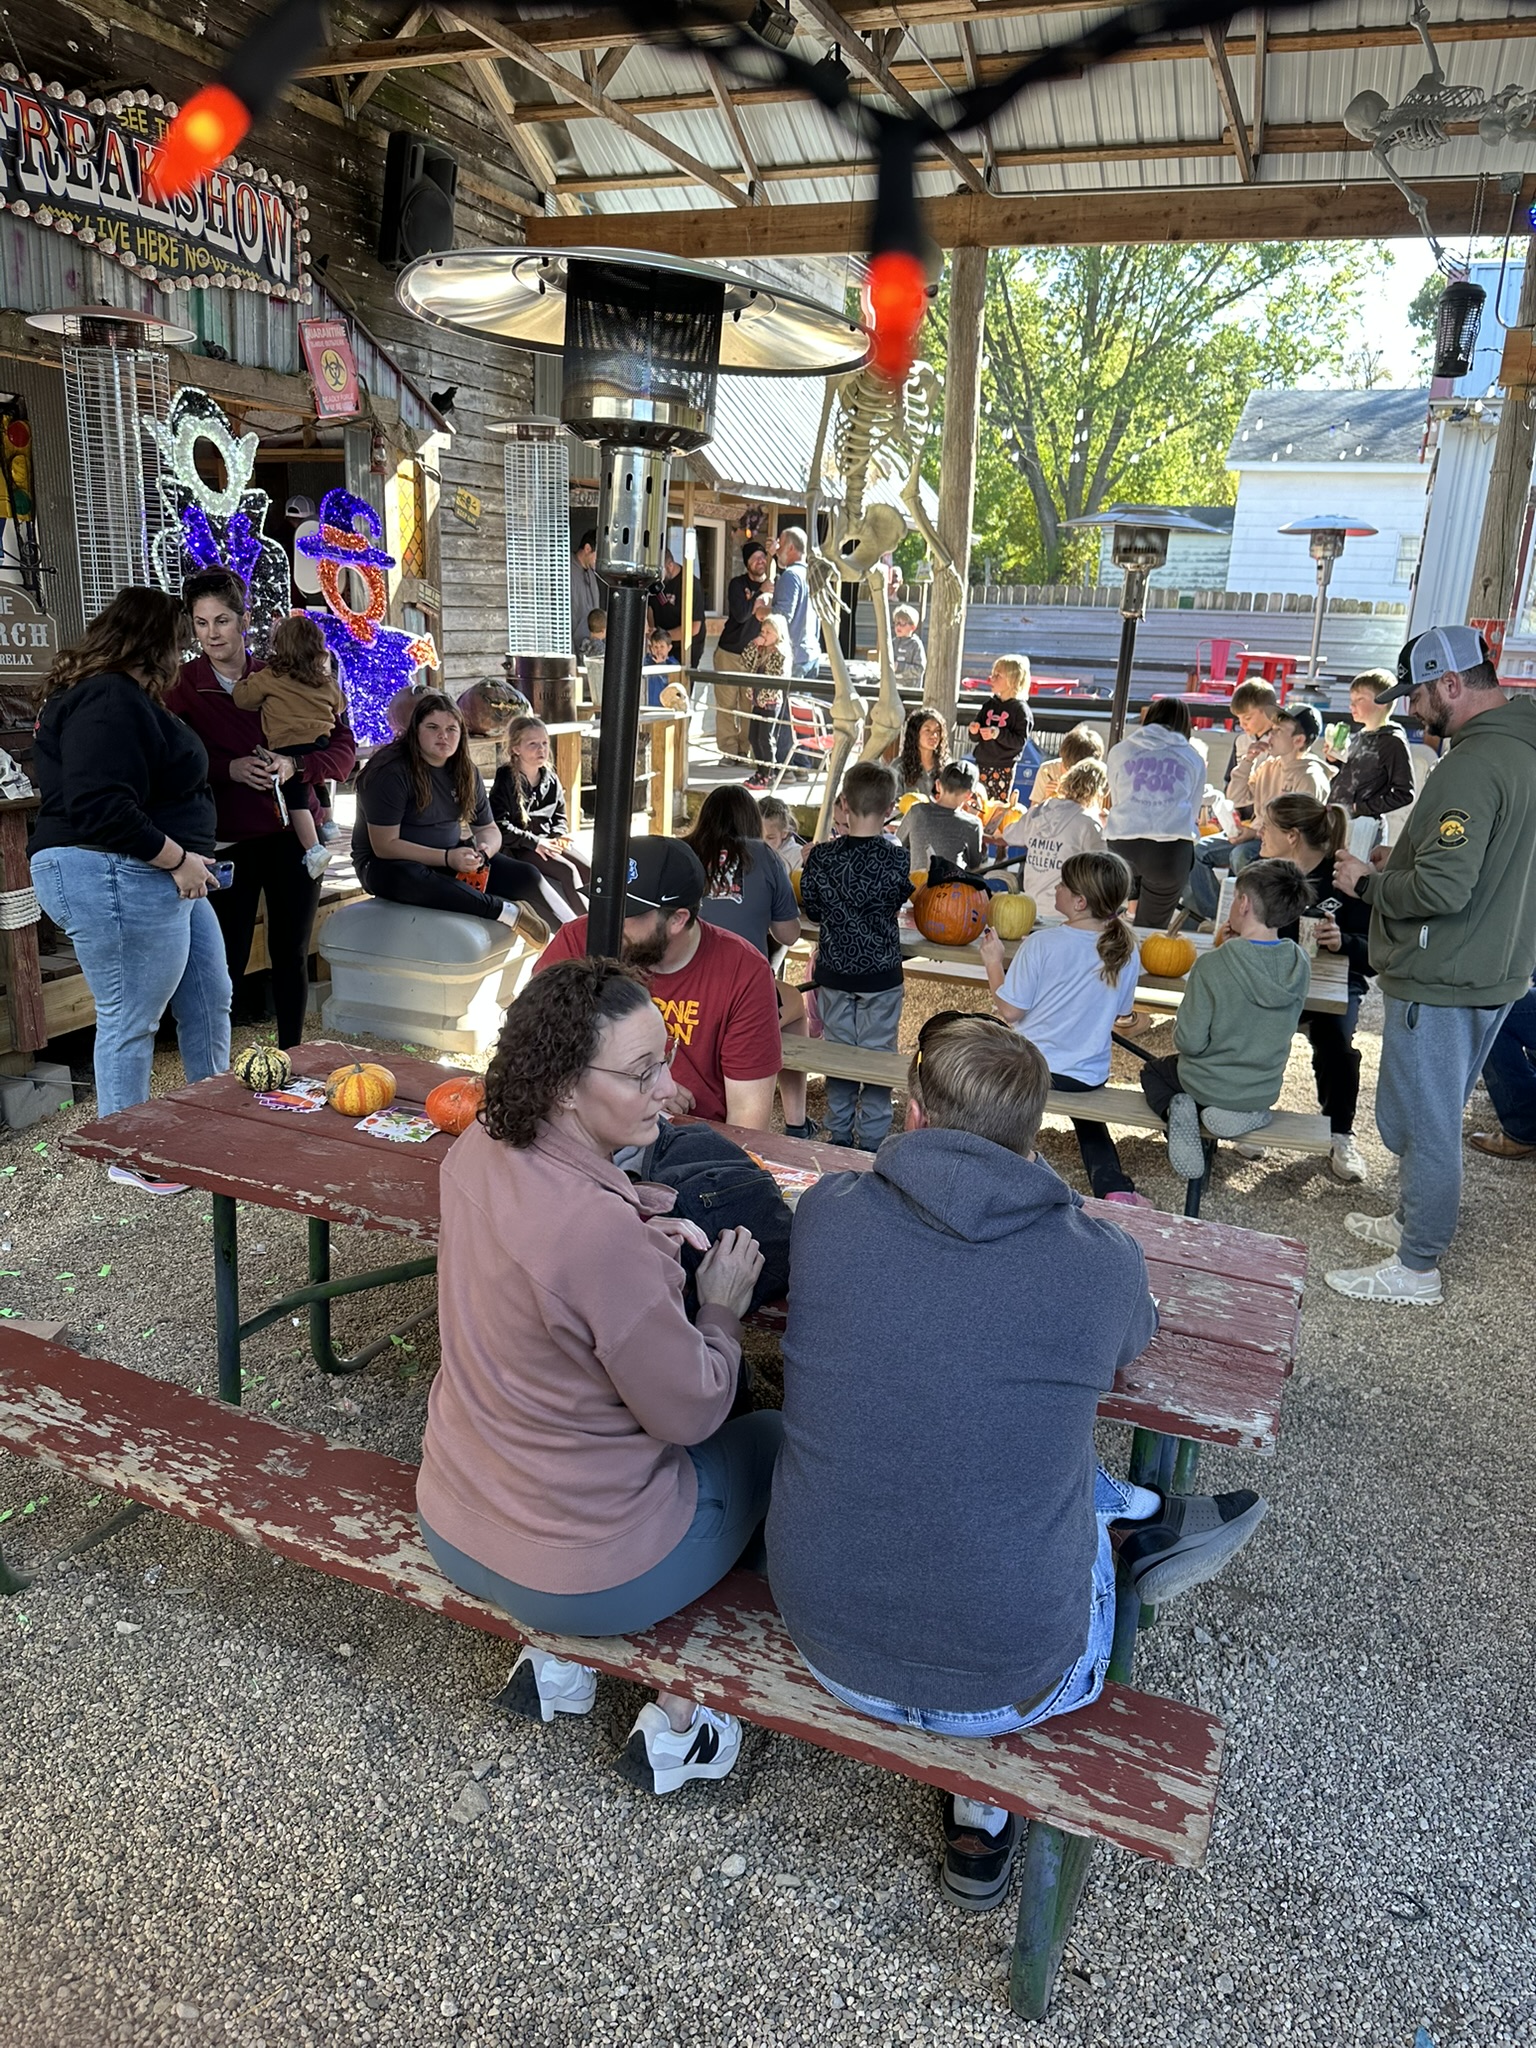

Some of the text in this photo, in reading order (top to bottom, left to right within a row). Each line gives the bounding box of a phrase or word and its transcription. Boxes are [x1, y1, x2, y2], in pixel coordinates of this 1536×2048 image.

[116, 106, 149, 134] SEE
[136, 226, 179, 269] HERE
[185, 243, 229, 274] NOW
[1124, 757, 1187, 782] WHITE
[1133, 772, 1177, 795] FOX
[1029, 837, 1063, 852] FAMILY
[1026, 855, 1063, 870] CELLENC
